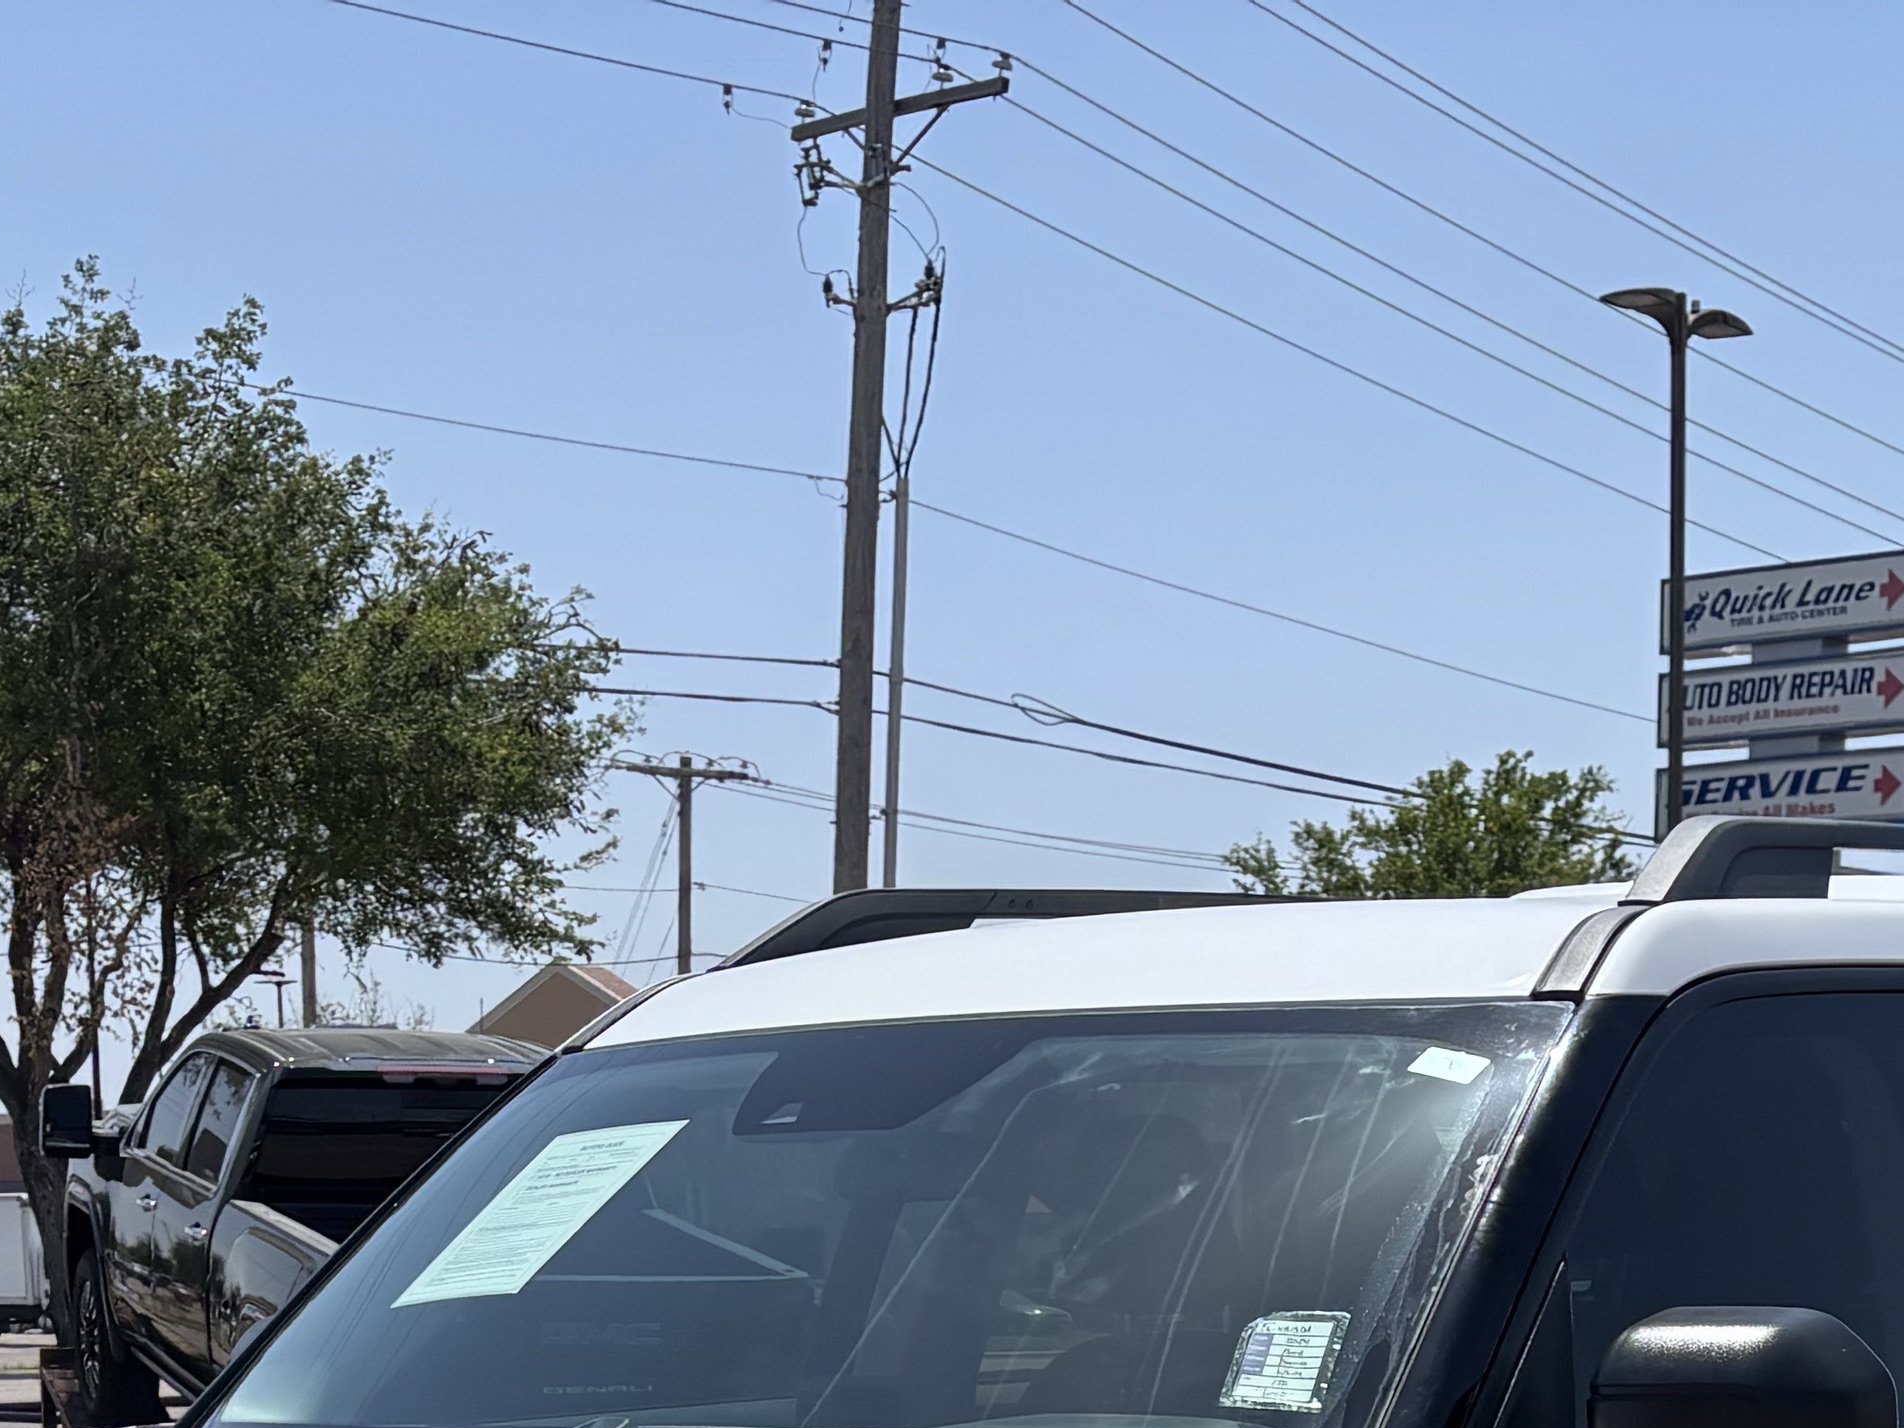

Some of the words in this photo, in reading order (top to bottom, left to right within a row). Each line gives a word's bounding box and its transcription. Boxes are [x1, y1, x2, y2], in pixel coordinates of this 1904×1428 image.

[1710, 581, 1795, 620] Quick
[1797, 578, 1877, 608] Lane
[1767, 611, 1799, 623] AUTO
[1801, 606, 1848, 619] CENTER
[1683, 681, 1722, 711] UTO
[1726, 674, 1788, 707] BODY
[1789, 666, 1875, 700] REPAIR
[1707, 711, 1750, 725] Accept
[1754, 708, 1771, 720] All
[1774, 704, 1840, 718] Insurance
